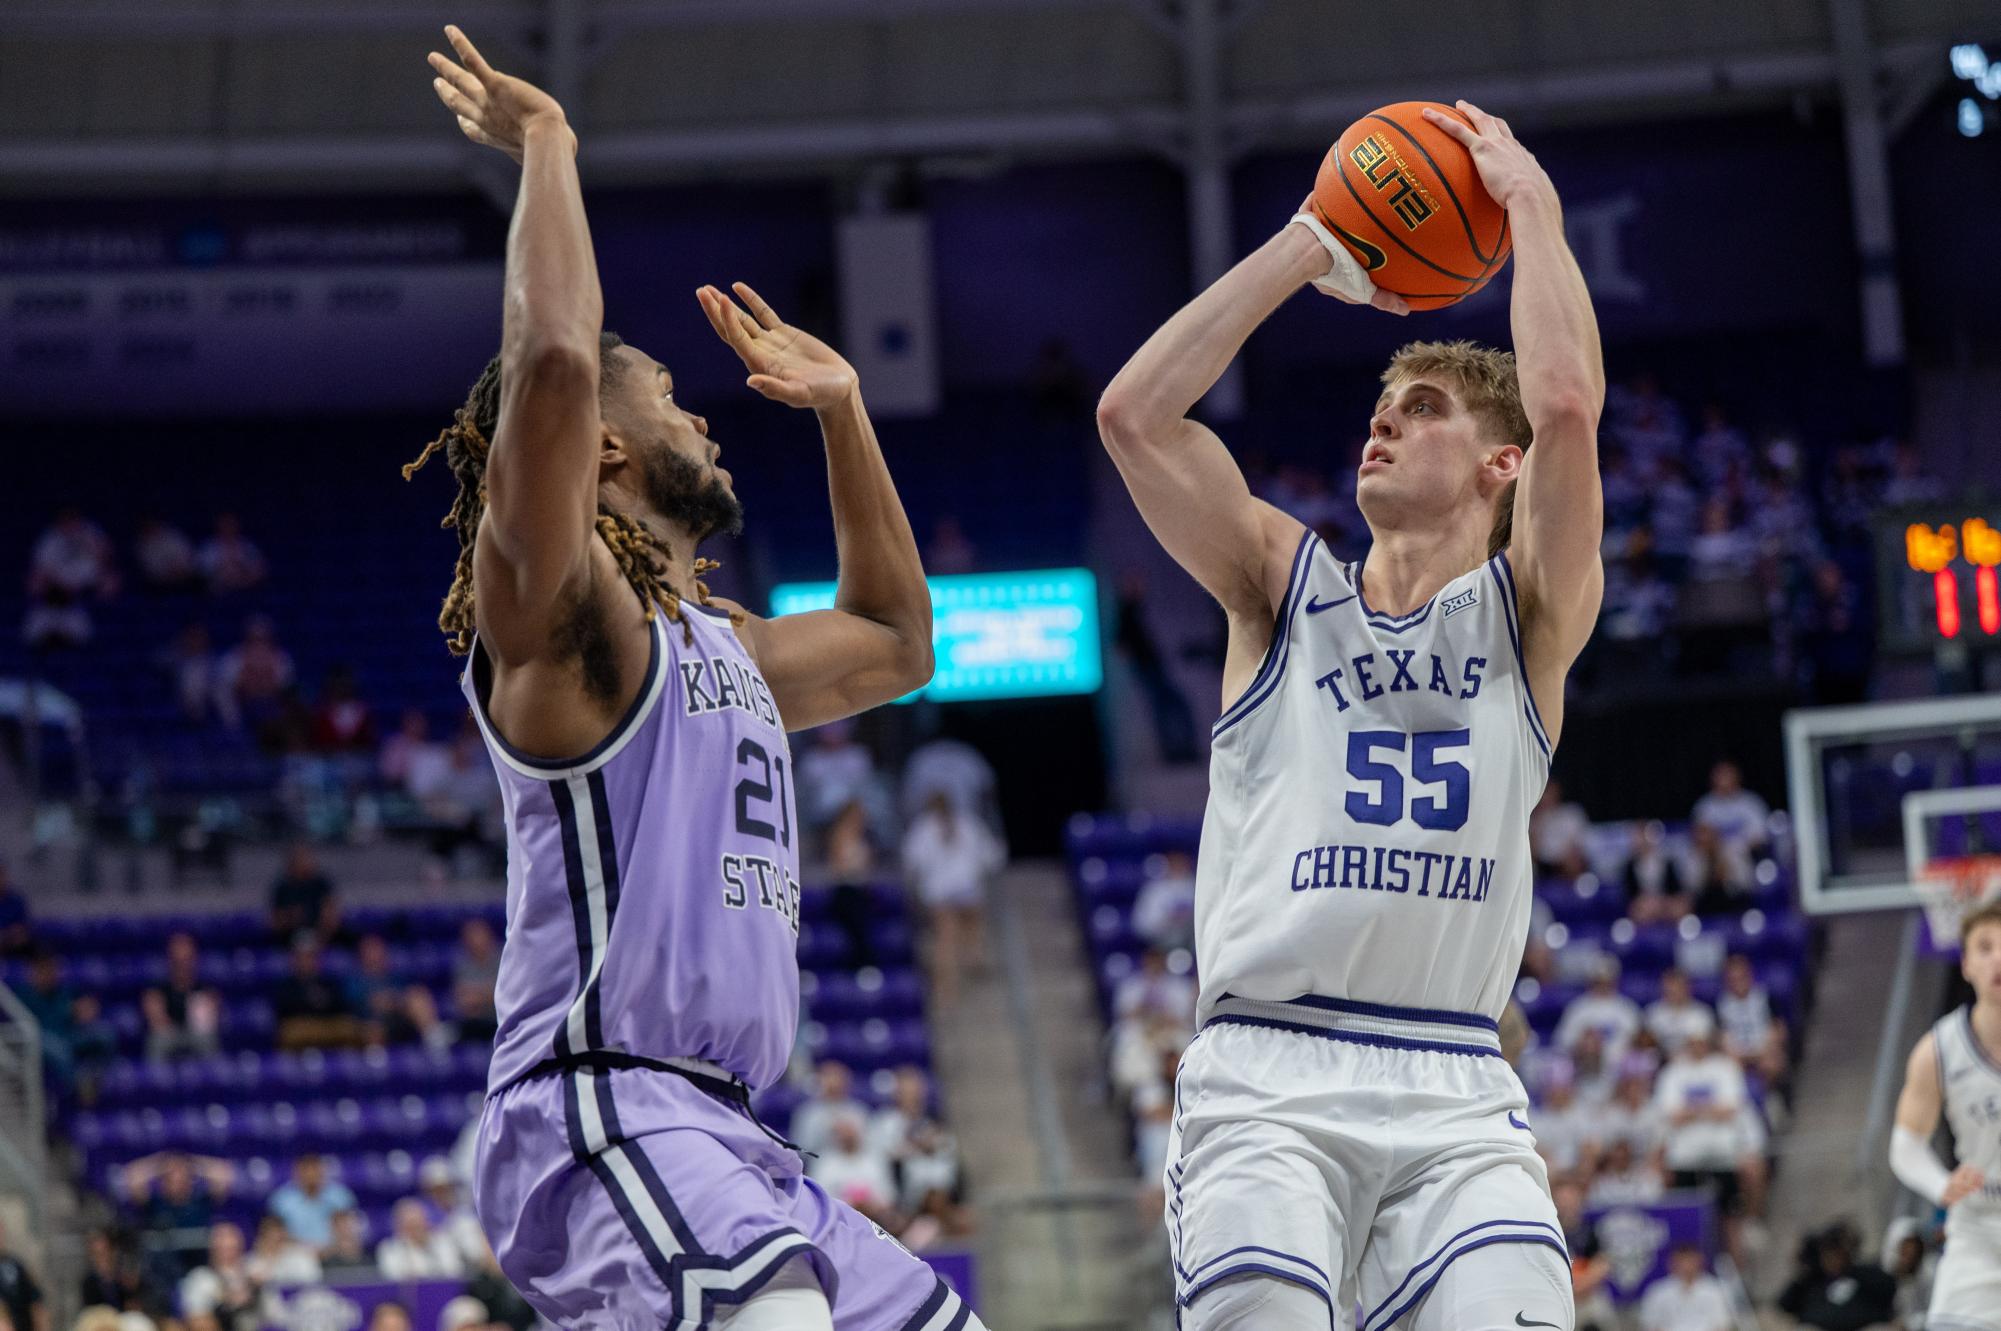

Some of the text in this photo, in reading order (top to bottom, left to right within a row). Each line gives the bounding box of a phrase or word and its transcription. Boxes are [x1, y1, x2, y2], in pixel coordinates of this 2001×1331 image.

[1350, 134, 1434, 231] ELITE
[679, 656, 779, 730] KANS
[1315, 649, 1487, 713] TEXAS
[735, 737, 790, 852] 21
[1344, 727, 1470, 832] 55
[721, 853, 800, 936] STAE
[1291, 845, 1495, 902] CHRISTIAN
